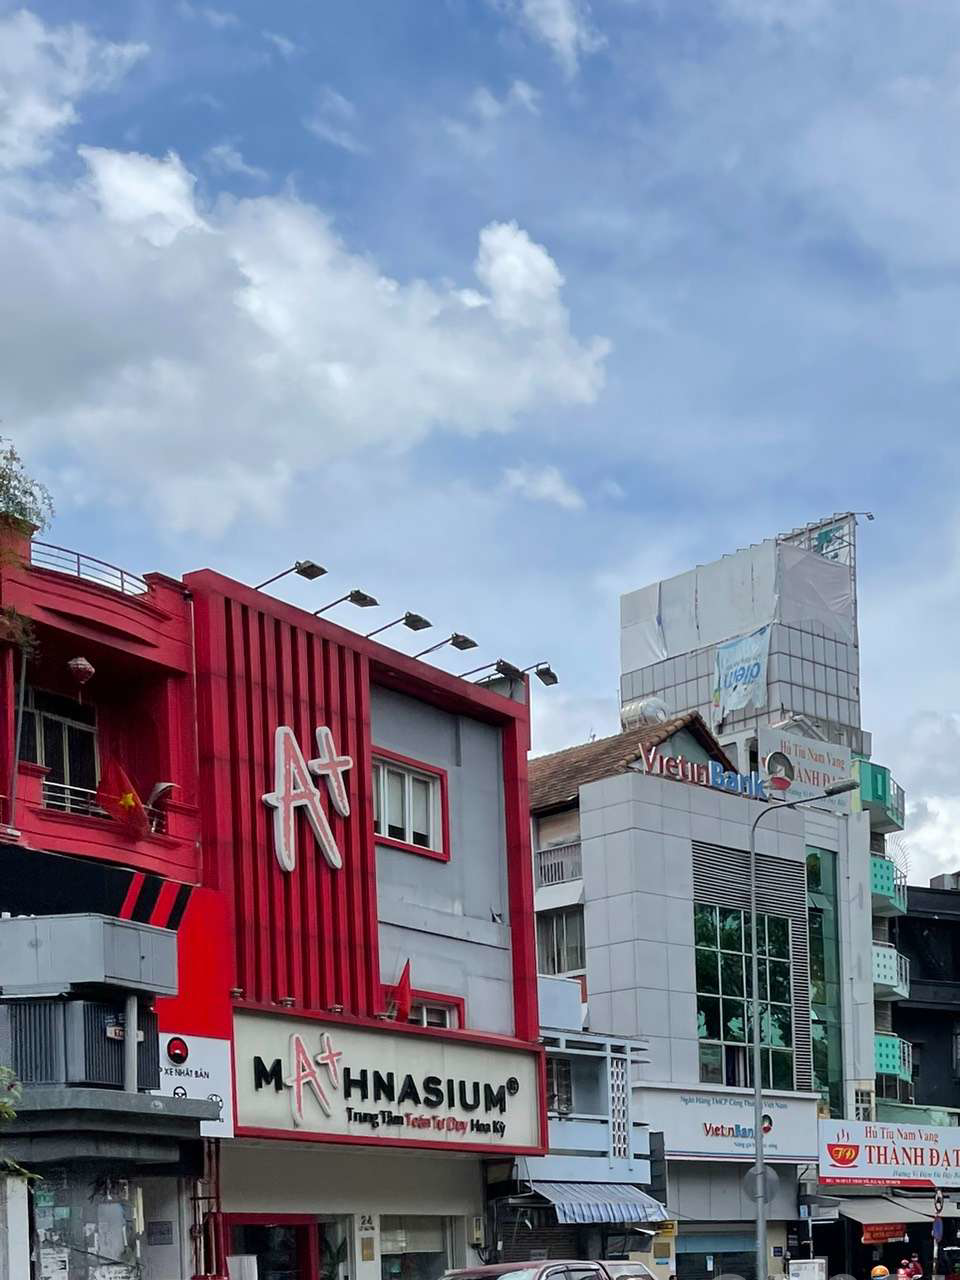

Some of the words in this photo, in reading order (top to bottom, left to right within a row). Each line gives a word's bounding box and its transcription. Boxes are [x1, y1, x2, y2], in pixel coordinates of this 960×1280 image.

[896, 1128, 916, 1141] Nam
[918, 1129, 939, 1143] Vang
[865, 1141, 924, 1165] THÀNH
